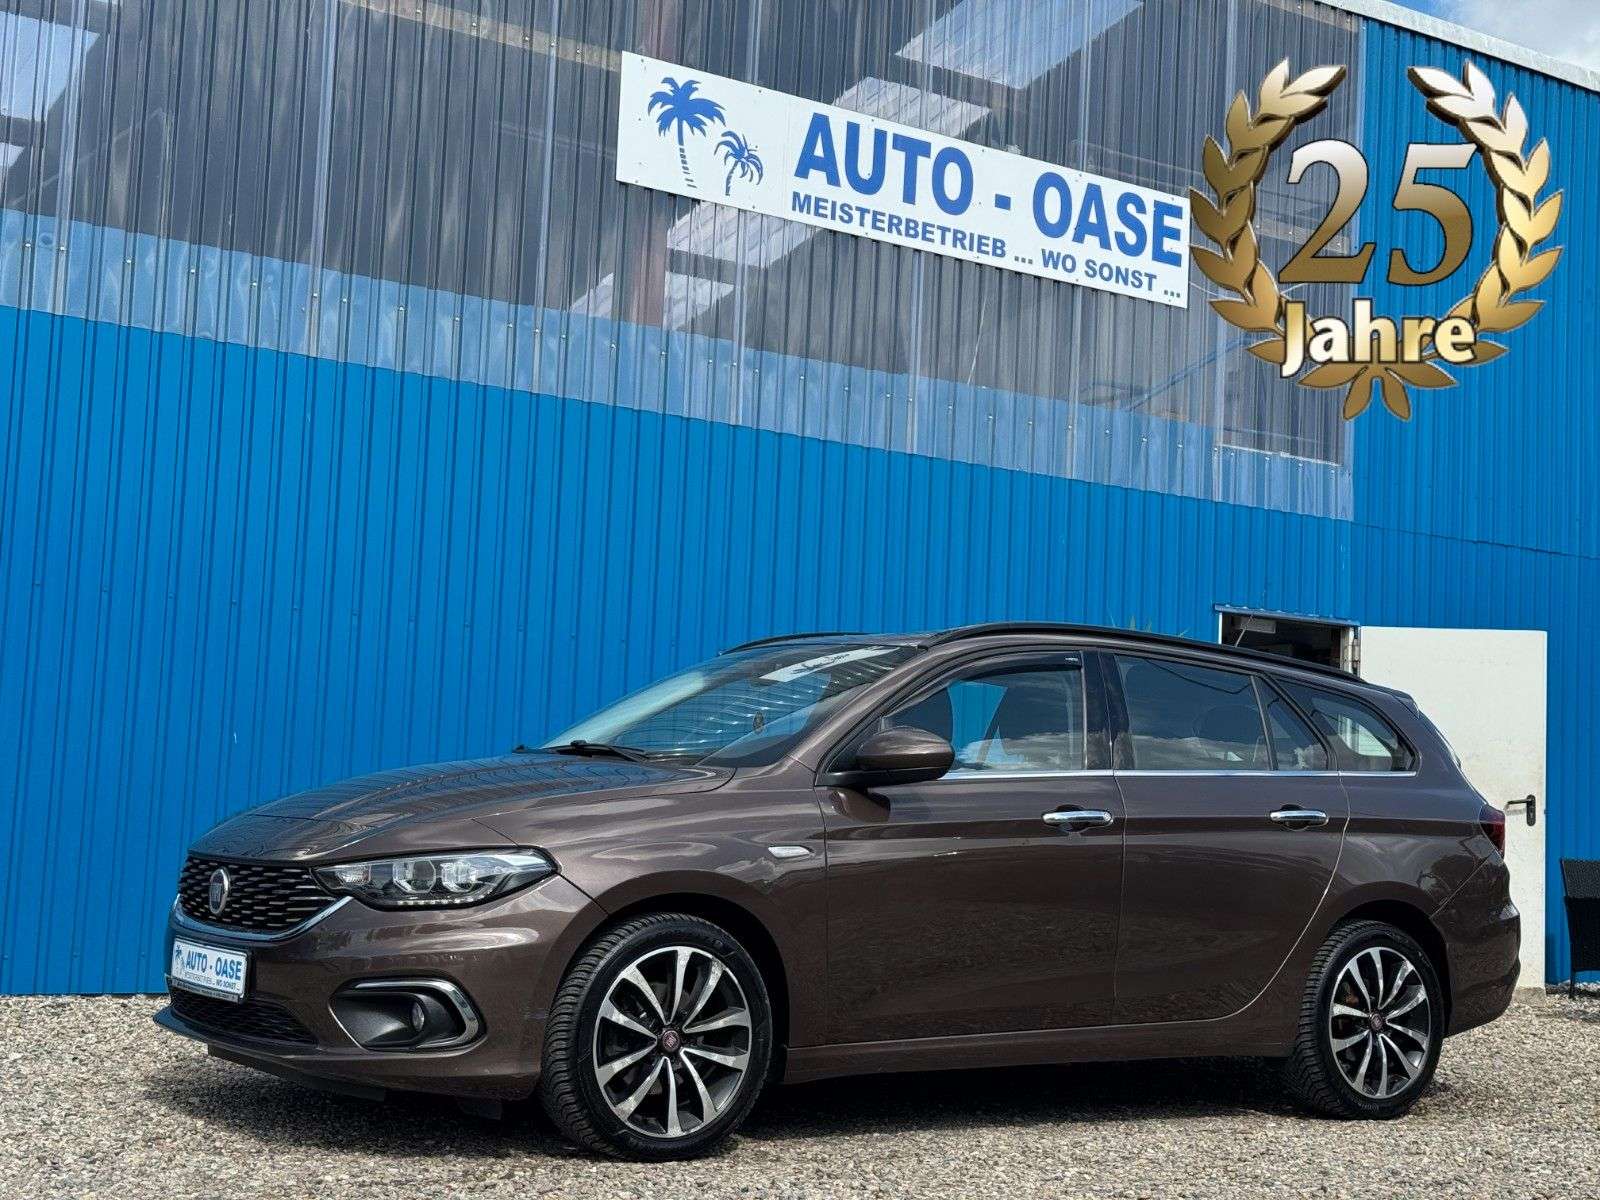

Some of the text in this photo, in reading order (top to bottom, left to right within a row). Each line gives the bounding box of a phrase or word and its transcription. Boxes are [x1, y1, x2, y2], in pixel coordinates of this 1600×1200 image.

[792, 190, 1006, 257] MEISTERBETRIEB
[1041, 250, 1078, 274] WO
[1085, 259, 1157, 290] SONST
[794, 112, 974, 216] AUTO
[1032, 171, 1184, 268] OASE
[186, 949, 208, 973] AUTO
[215, 957, 242, 980] OASE
